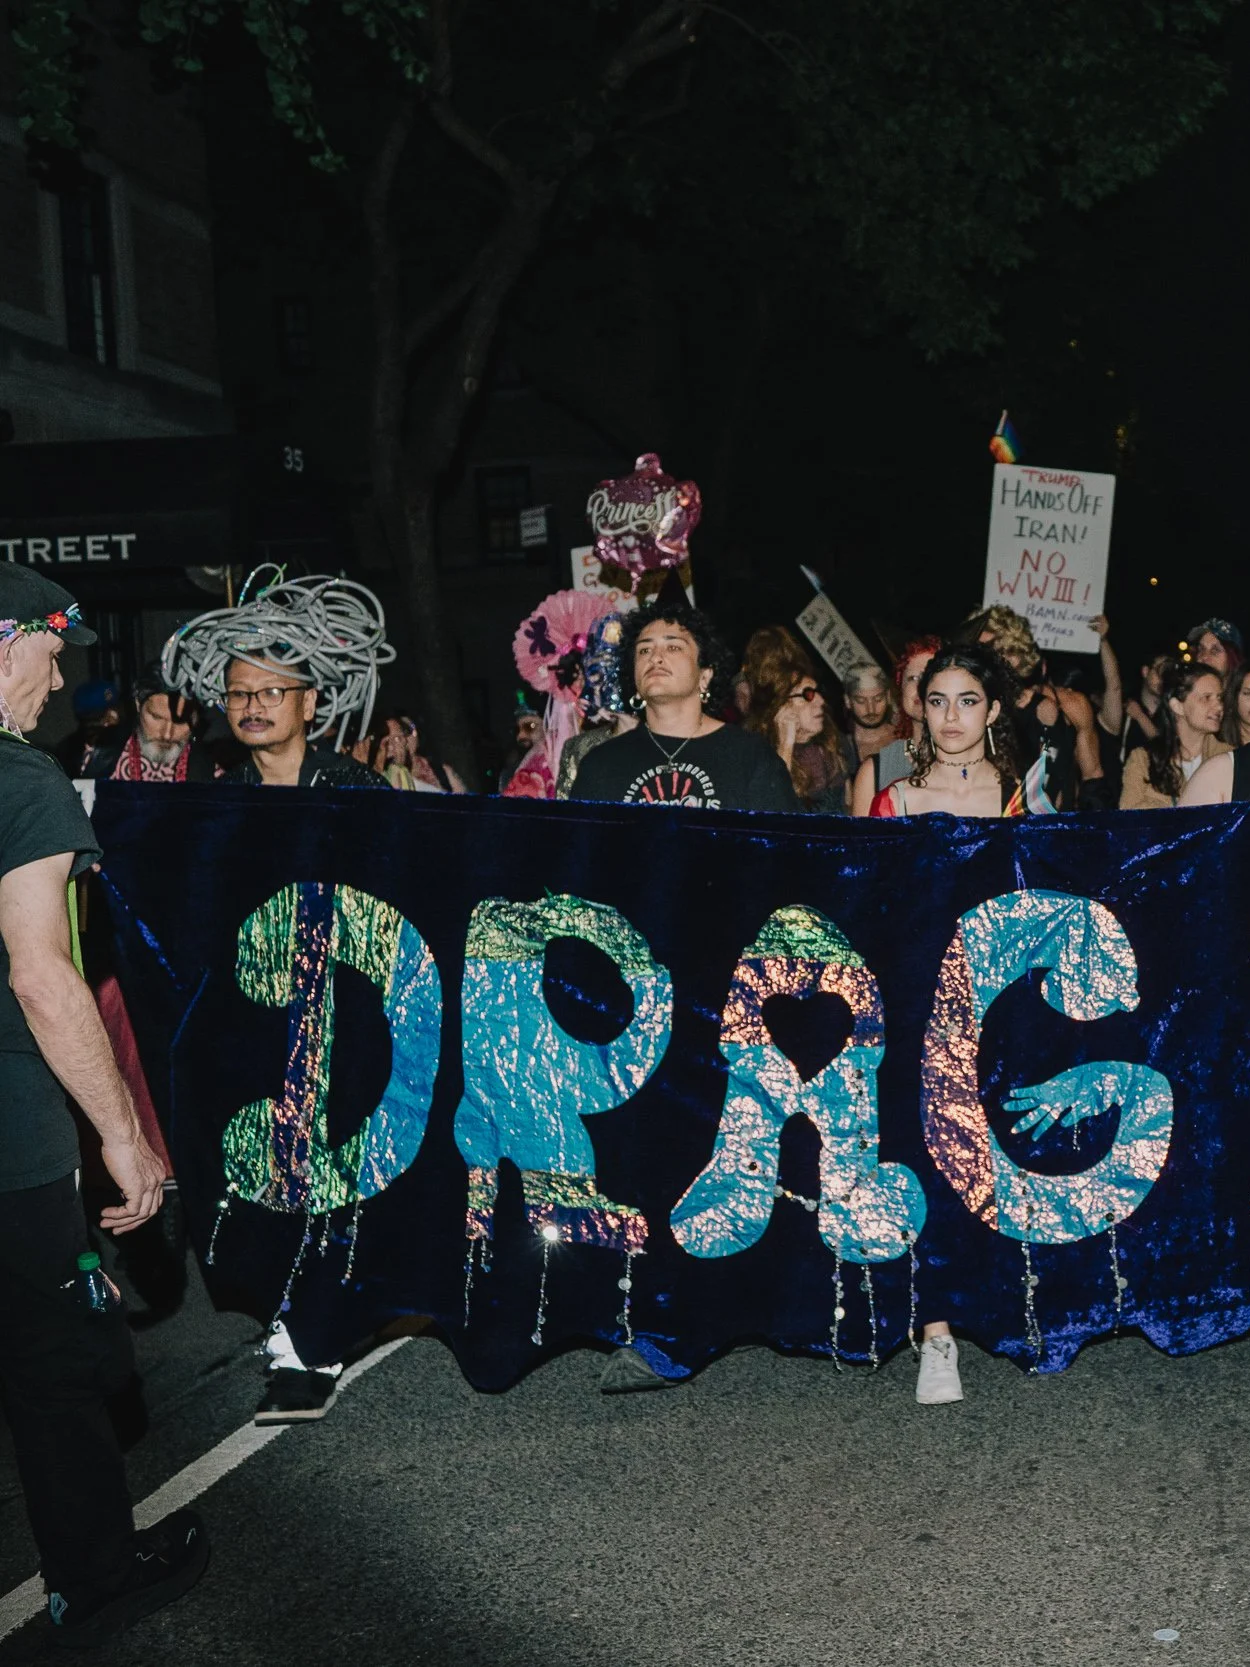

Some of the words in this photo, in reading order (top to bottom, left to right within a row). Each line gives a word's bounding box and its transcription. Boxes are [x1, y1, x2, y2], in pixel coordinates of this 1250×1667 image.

[283, 445, 304, 473] 35
[1001, 478, 1064, 512] HANDS
[1068, 483, 1104, 516] OFF
[1013, 515, 1089, 544] IRAN!
[1020, 549, 1066, 575] NO
[222, 882, 1174, 1264] DRAG
